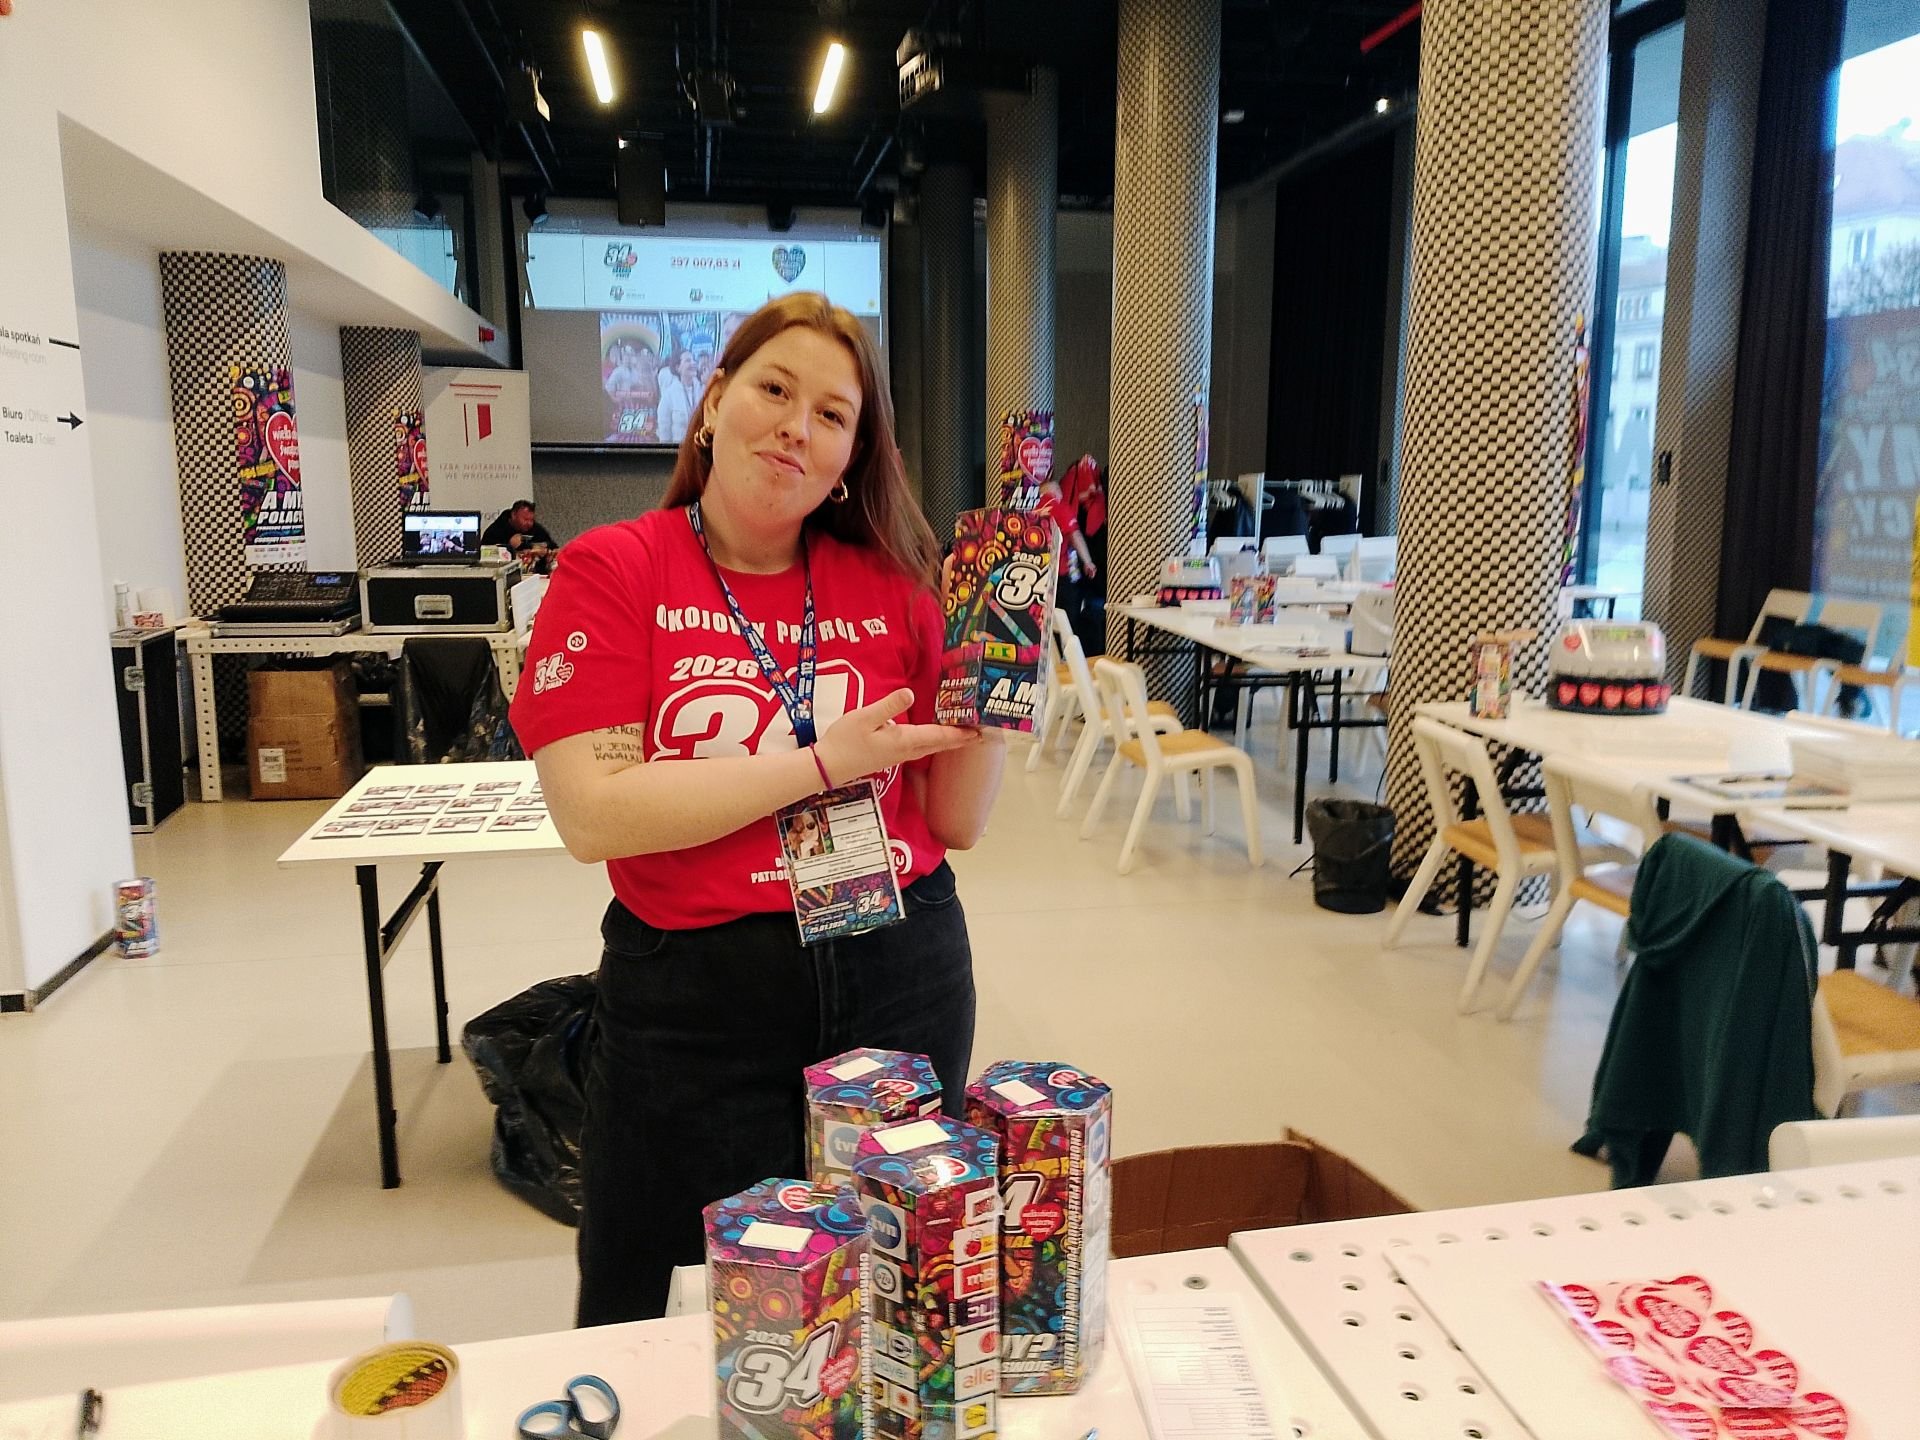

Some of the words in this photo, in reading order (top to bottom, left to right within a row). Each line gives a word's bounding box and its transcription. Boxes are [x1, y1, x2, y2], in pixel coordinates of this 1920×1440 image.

[10, 330, 41, 346] spotkań
[2, 406, 23, 421] Biuro
[4, 430, 34, 444] Toaleta
[261, 491, 277, 510] A
[776, 616, 860, 644] PAROL
[668, 655, 759, 681] 2026
[990, 678, 1012, 700] A
[1013, 681, 1040, 705] M
[985, 698, 1032, 714] ROBIMY
[857, 890, 883, 915] 34
[870, 1214, 898, 1238] tvn
[743, 1329, 793, 1348] 2026
[727, 1322, 840, 1413] 34
